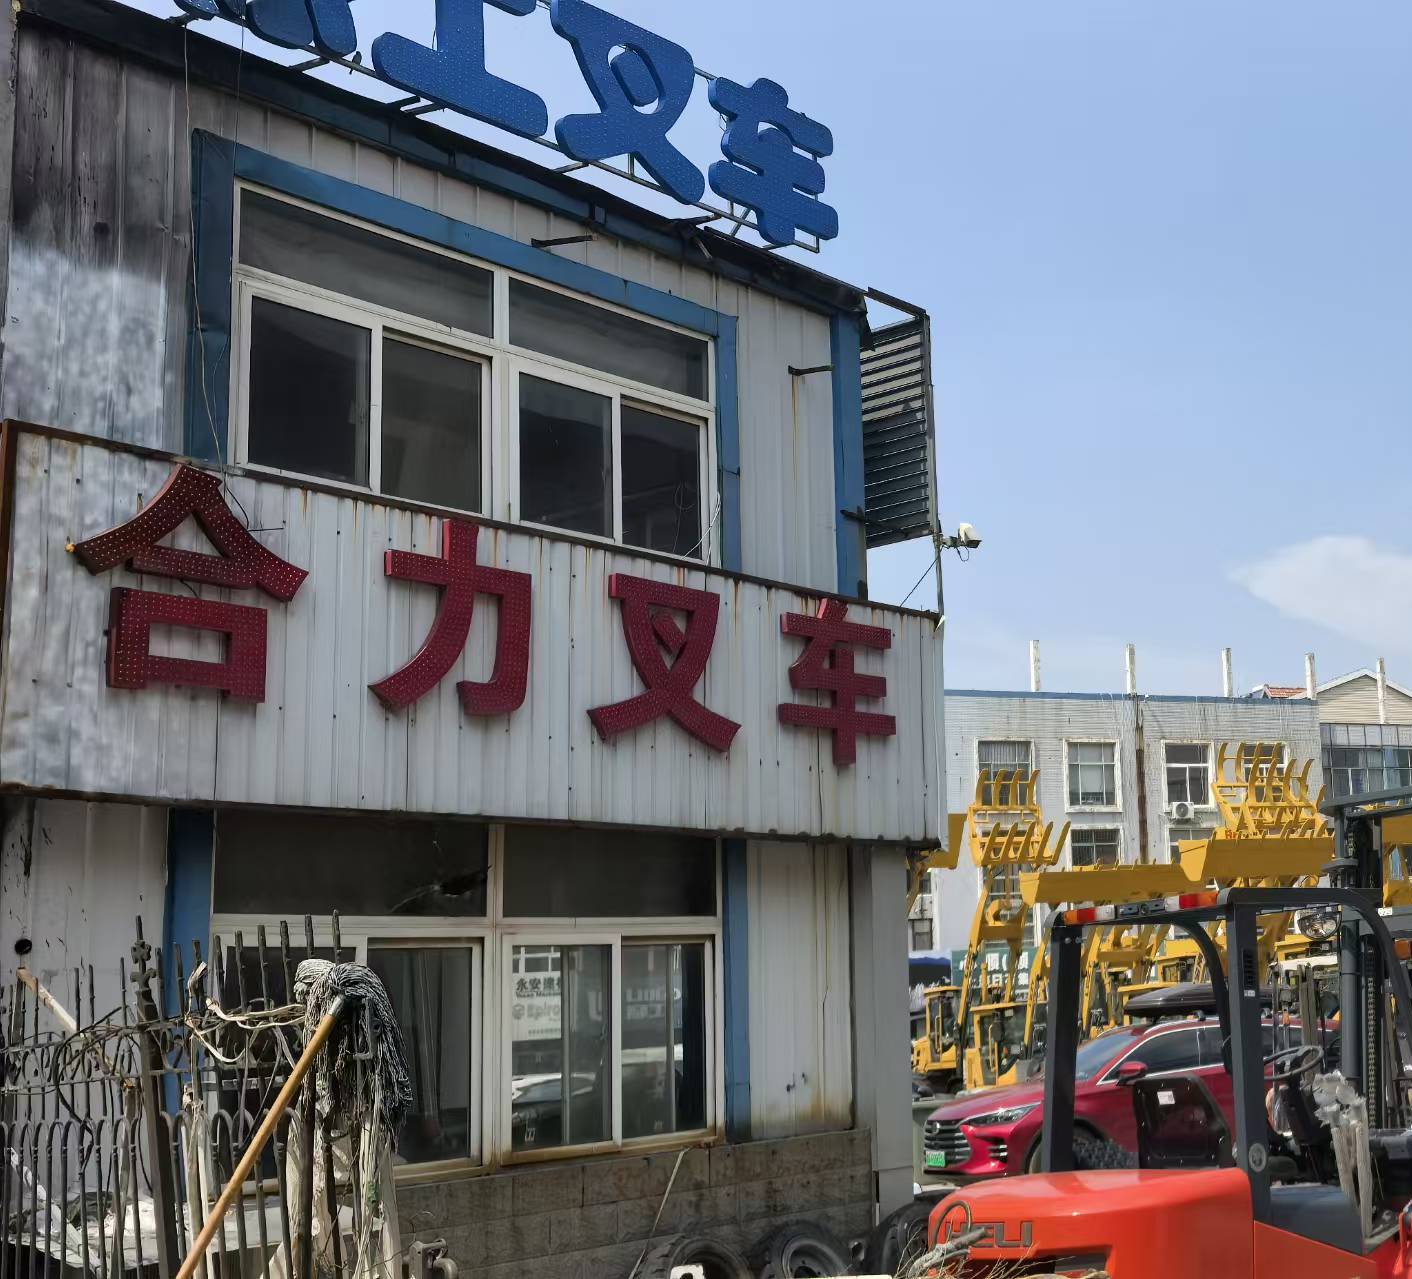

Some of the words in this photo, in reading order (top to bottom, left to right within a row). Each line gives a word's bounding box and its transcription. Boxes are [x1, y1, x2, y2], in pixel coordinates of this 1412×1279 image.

[74, 463, 897, 766] 合力叉车
[945, 1221, 1033, 1248] HELI
